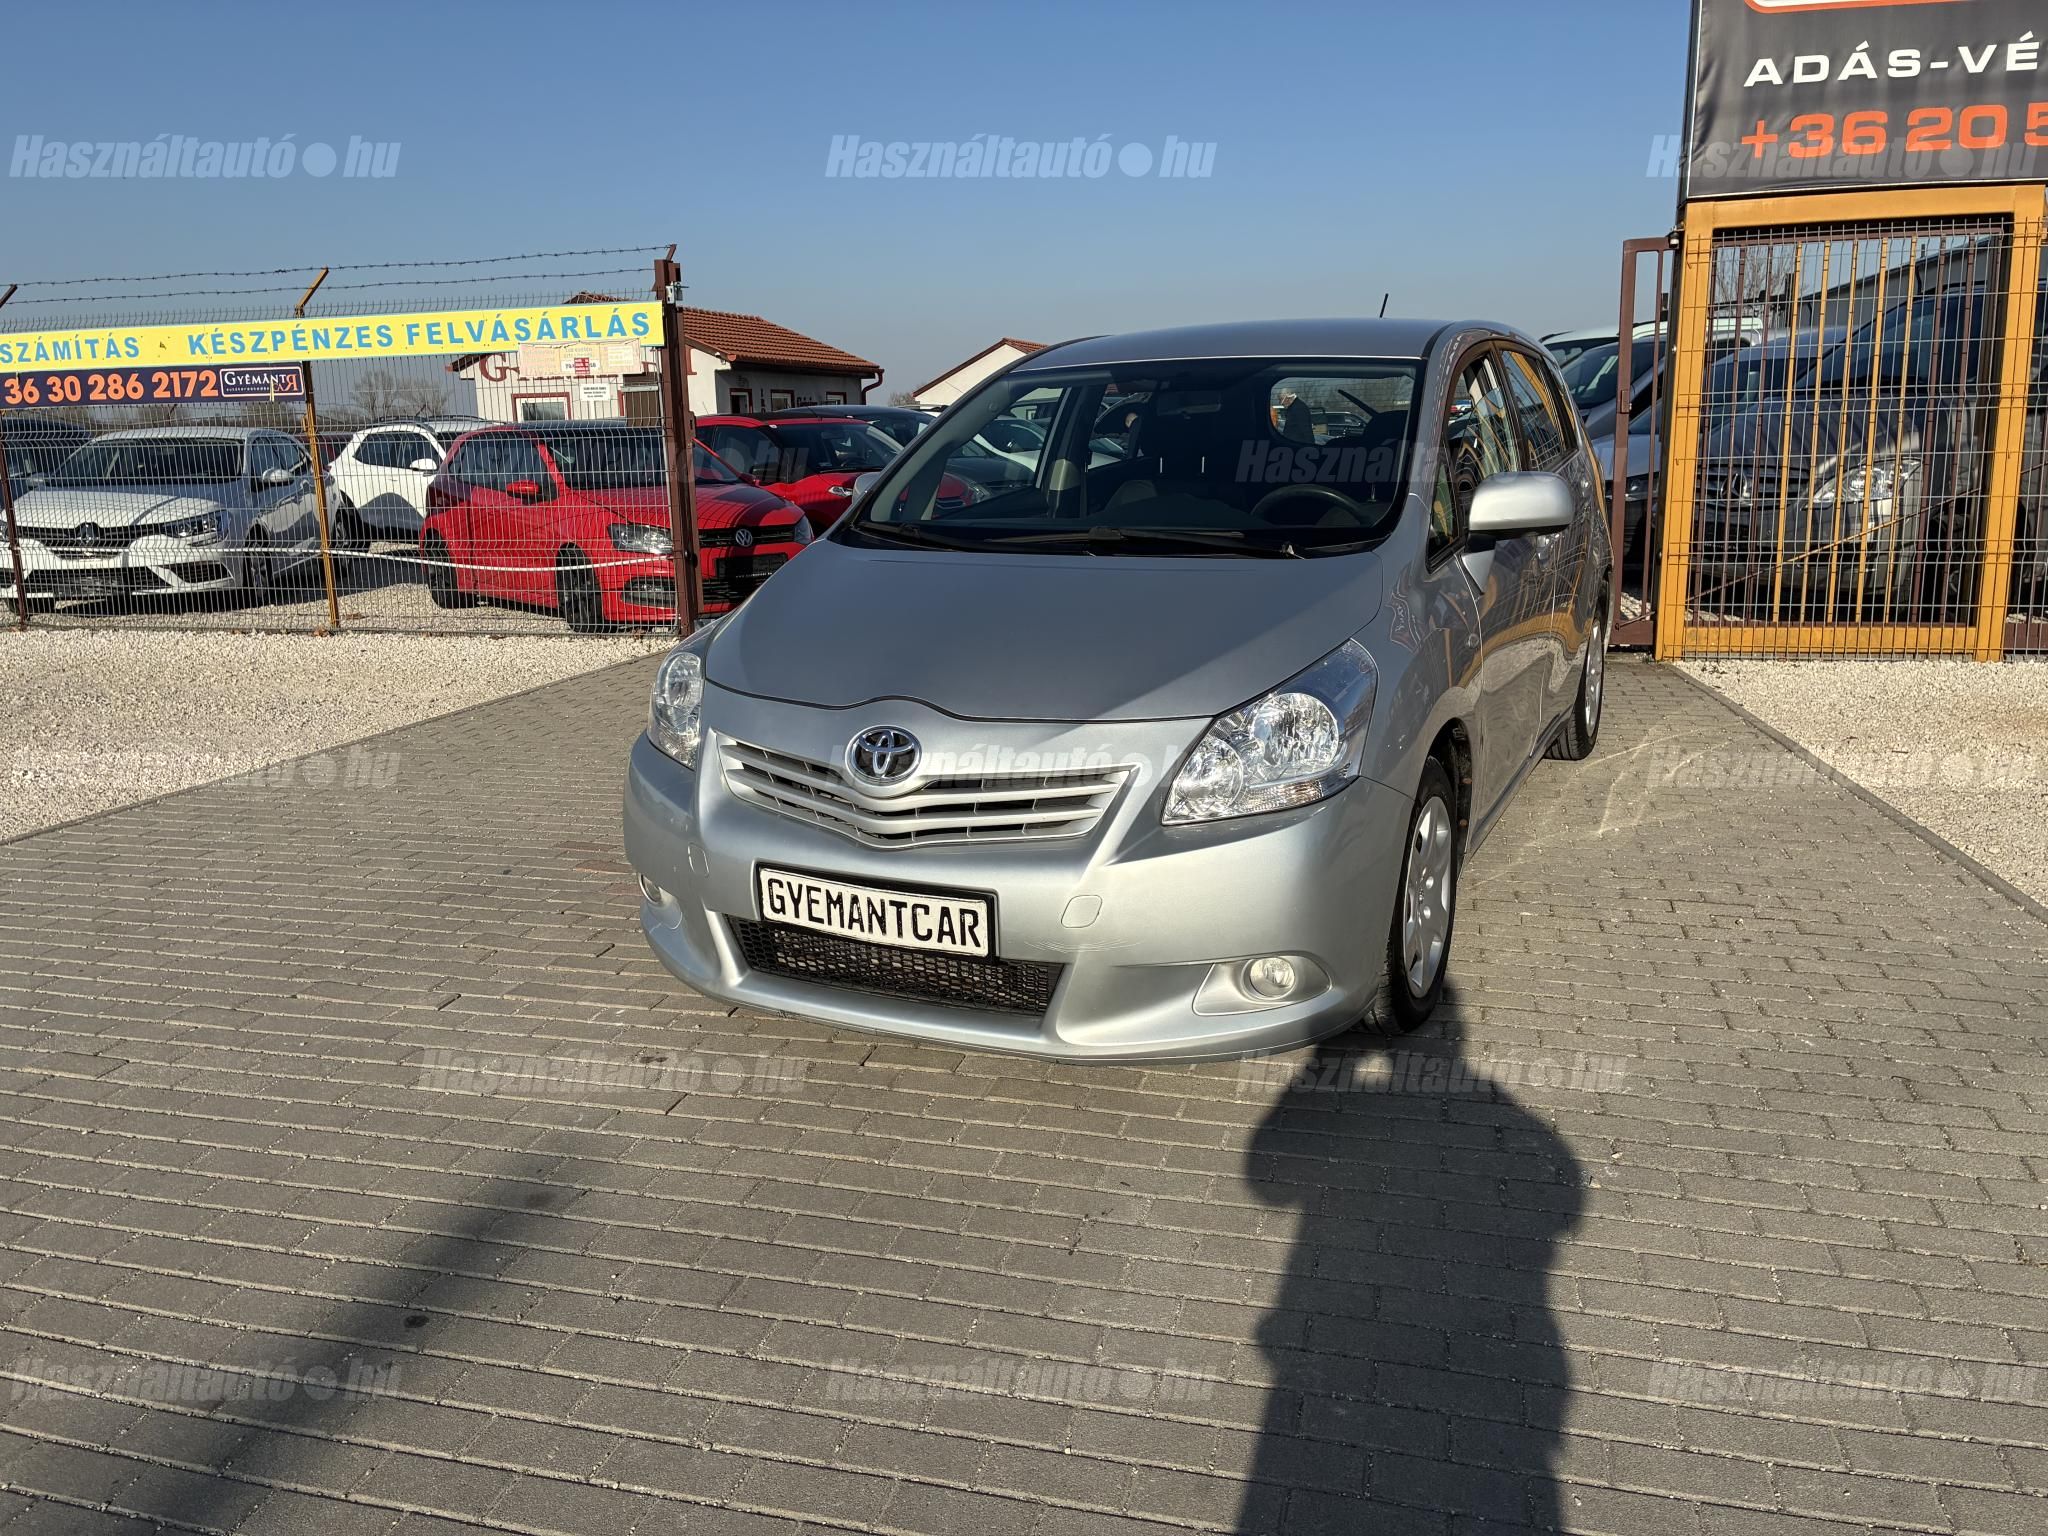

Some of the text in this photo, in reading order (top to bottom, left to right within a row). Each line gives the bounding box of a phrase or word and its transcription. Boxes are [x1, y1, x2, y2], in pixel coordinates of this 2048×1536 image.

[1743, 30, 2040, 88] ADÁS-VÉ
[1741, 110, 1889, 160] +36
[1905, 104, 2008, 153] 20
[0, 308, 650, 364] SZÁMÍTÁS KÉSZPÉNZES FELVÁSÁRLÁS
[4, 370, 219, 405] 36 30 286 2172
[767, 877, 981, 948] GYEMANTCAR
